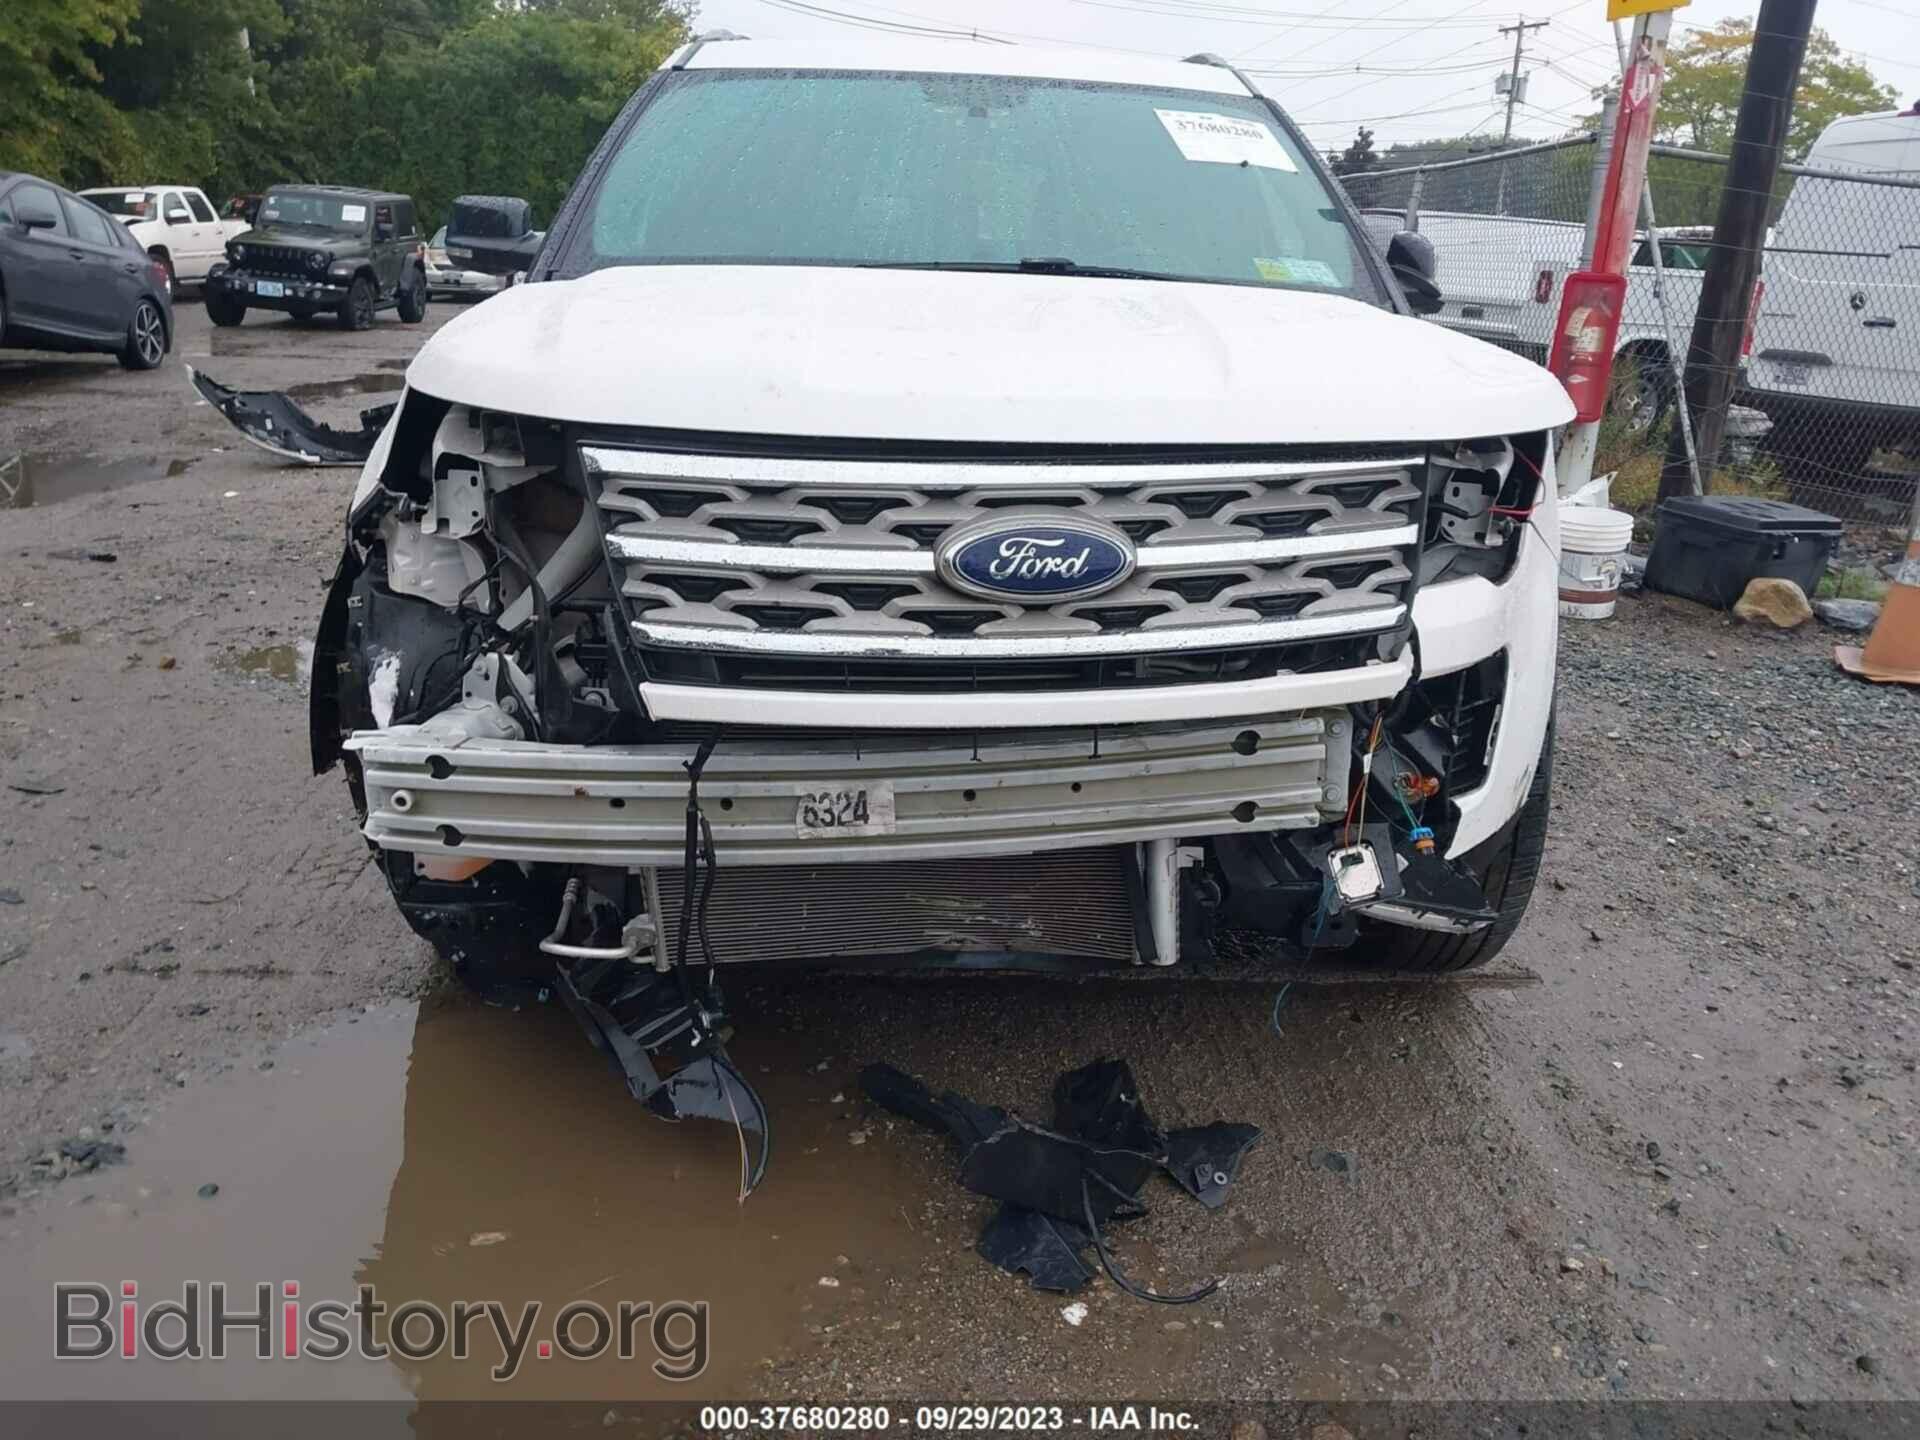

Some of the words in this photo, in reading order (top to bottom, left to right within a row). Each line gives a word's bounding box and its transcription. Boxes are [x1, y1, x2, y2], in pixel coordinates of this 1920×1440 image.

[1175, 119, 1264, 140] 37680280
[988, 537, 1091, 580] Ford
[803, 790, 870, 828] 6324
